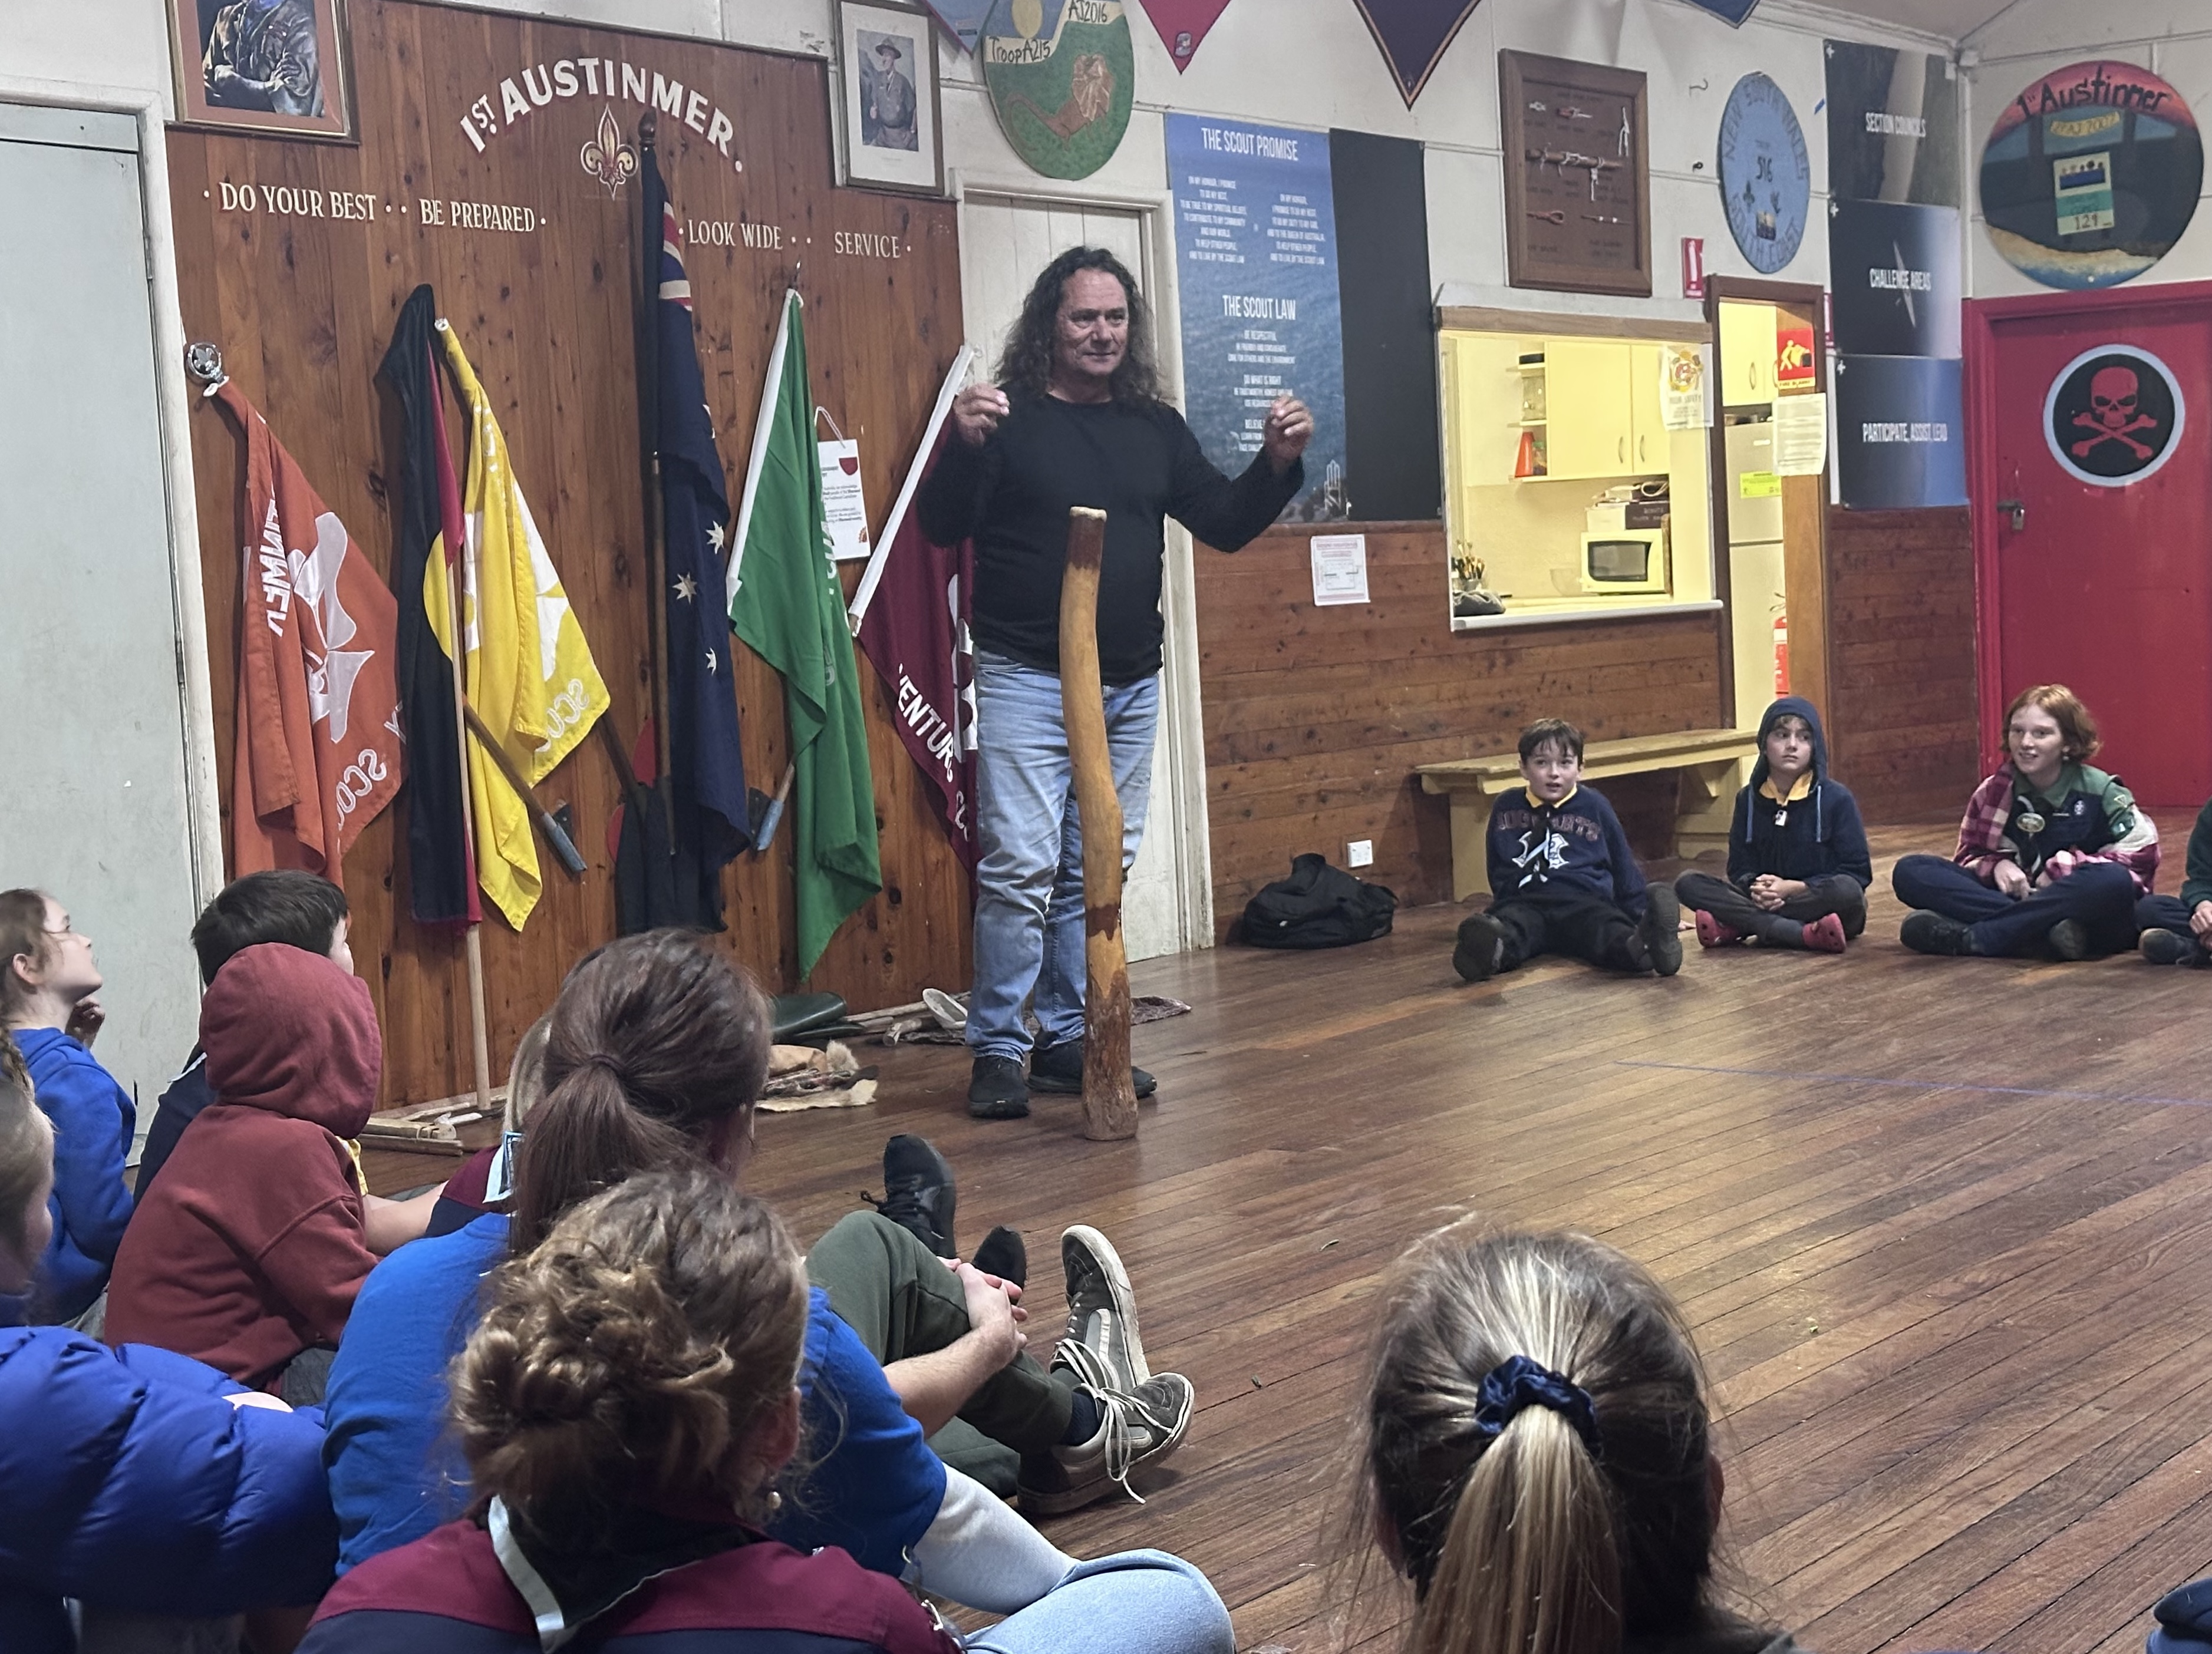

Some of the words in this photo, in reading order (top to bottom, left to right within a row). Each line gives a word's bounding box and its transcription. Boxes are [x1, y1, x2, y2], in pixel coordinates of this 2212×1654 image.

[1201, 127, 1222, 150] THE
[1223, 130, 1255, 155] SCOUT
[1256, 135, 1298, 161] PROMISE
[219, 181, 256, 212] DO
[259, 185, 325, 217] YOUR
[328, 190, 377, 220] BEST
[418, 199, 445, 225] BE
[450, 201, 535, 232] PREPARED
[687, 219, 736, 246] LOOK
[740, 223, 783, 250] WIDE
[835, 231, 902, 259] SERVICE
[1870, 268, 1909, 289] CHALLENGE
[1222, 295, 1241, 317] THE
[1243, 296, 1273, 319] SCOUT
[1275, 298, 1296, 320] LAW
